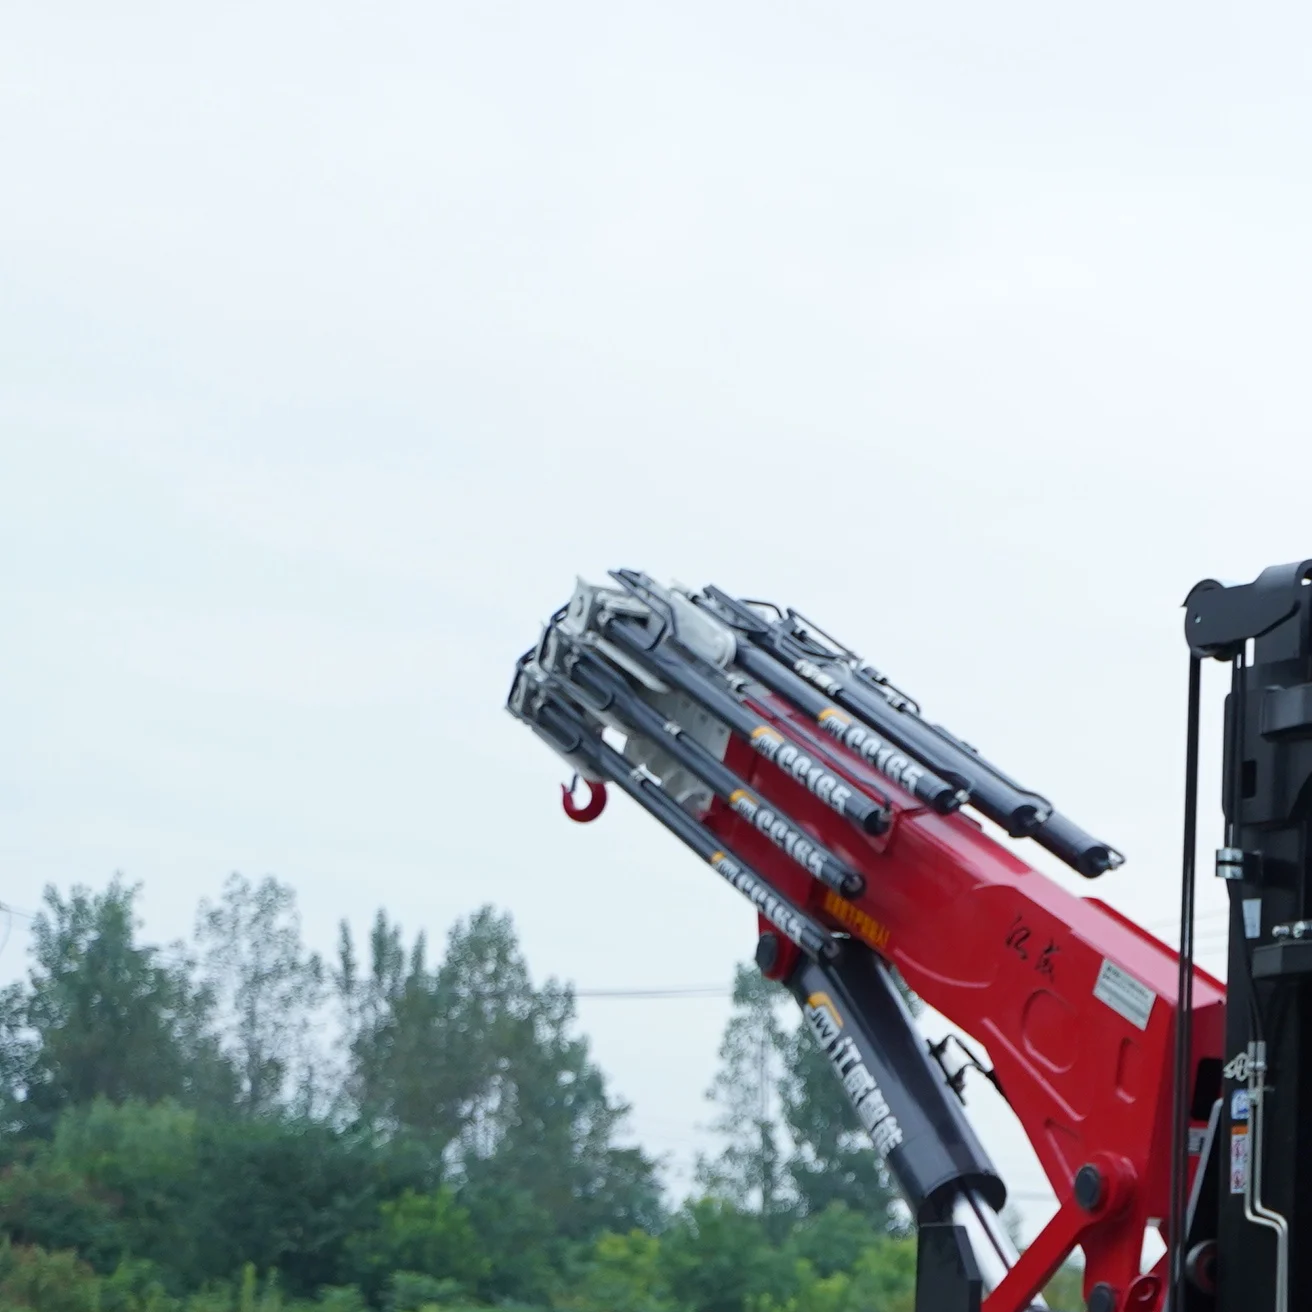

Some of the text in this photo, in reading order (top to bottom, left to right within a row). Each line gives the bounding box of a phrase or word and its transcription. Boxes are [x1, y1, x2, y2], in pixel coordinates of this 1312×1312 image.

[776, 744, 852, 816] CC165
[845, 726, 925, 795] CC165
[754, 808, 828, 879] CC165
[734, 872, 806, 945] CC165
